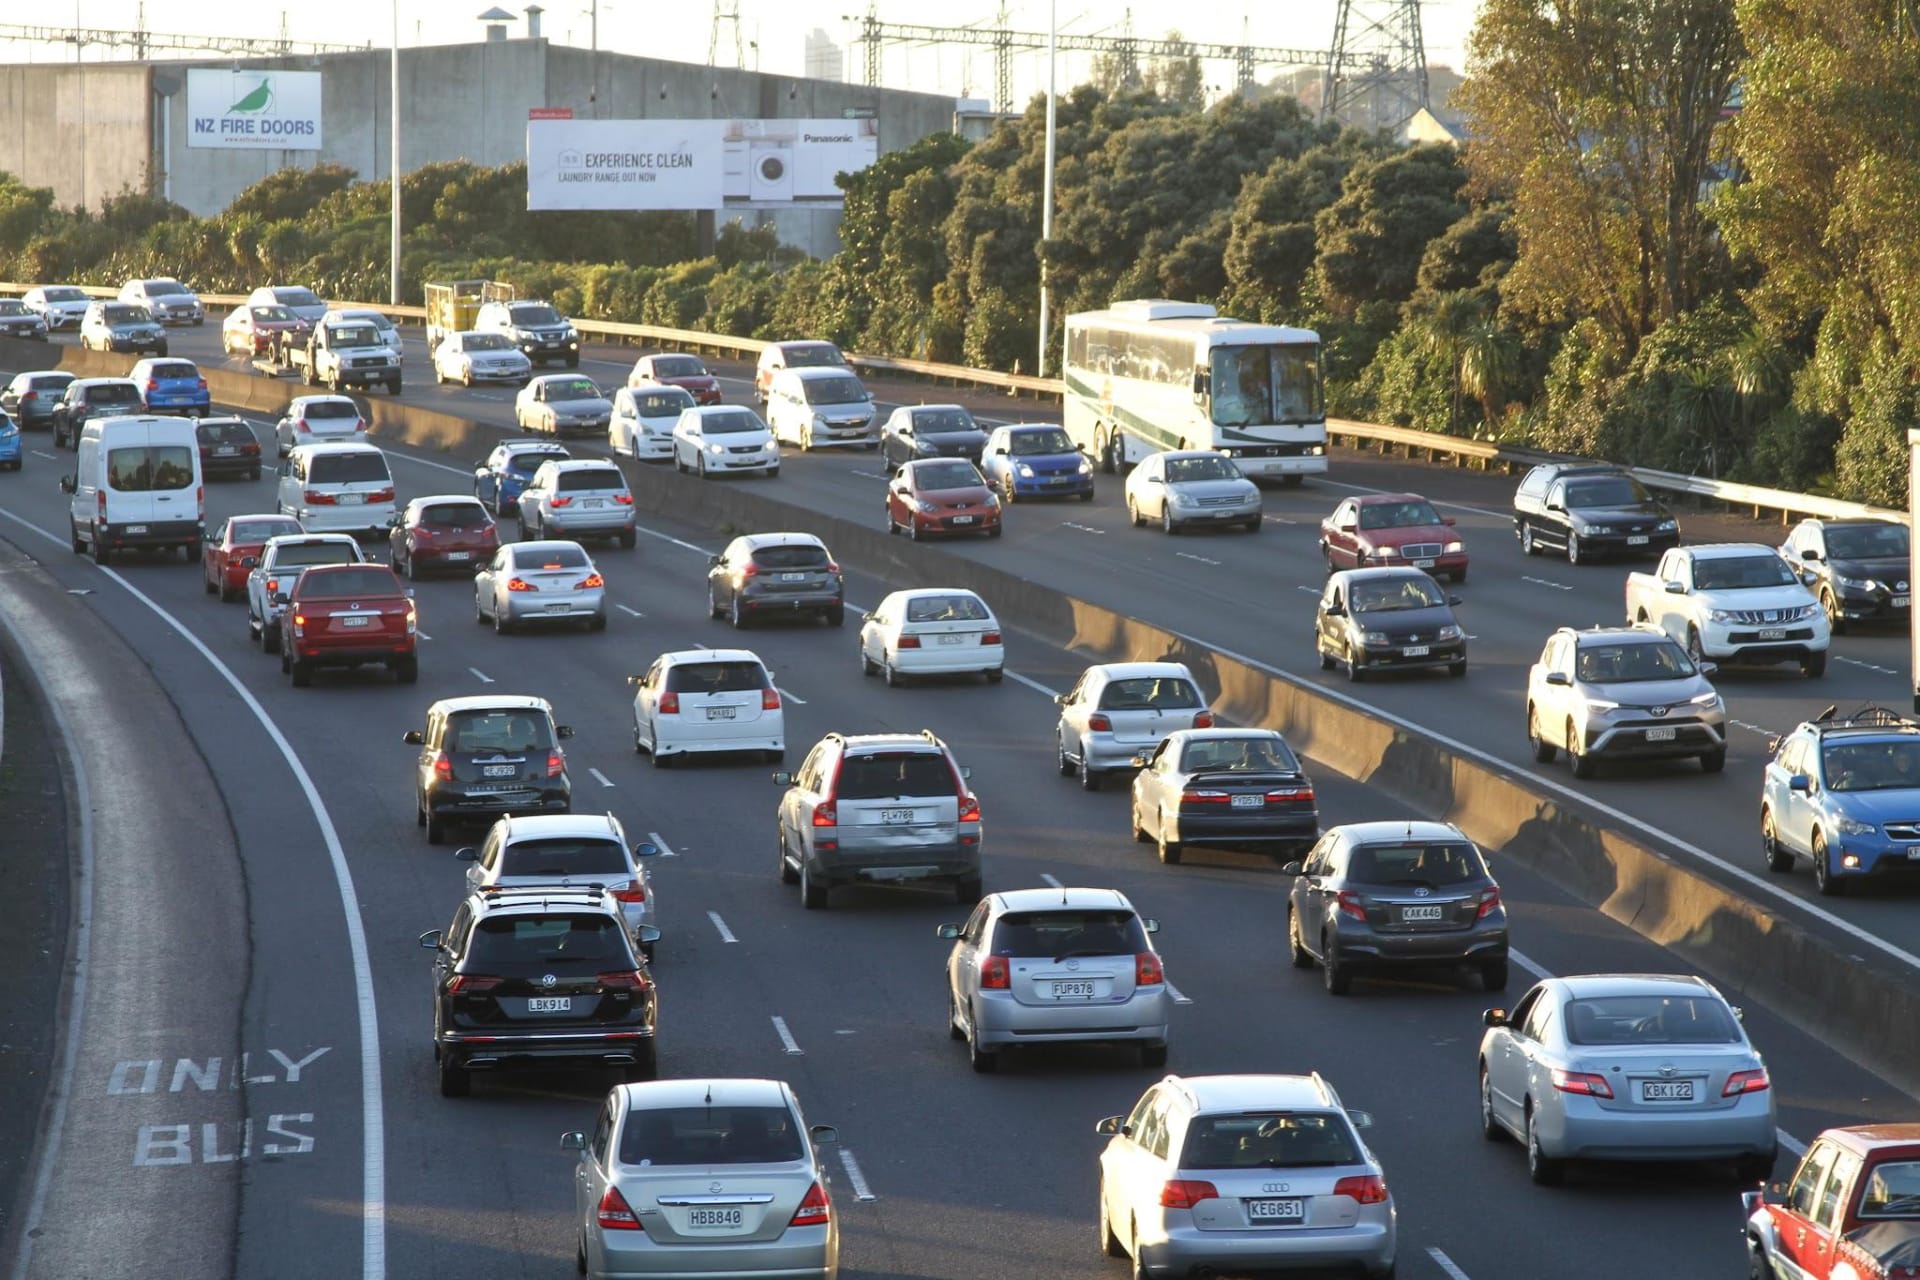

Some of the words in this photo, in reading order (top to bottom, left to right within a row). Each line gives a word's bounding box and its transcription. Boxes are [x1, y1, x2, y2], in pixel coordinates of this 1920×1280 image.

[194, 118, 215, 133] NZ
[221, 118, 255, 134] FIRE
[261, 119, 315, 135] DOORS
[803, 133, 853, 143] Panasonic
[585, 153, 652, 168] EXPERIENCE
[656, 153, 693, 168] CLEAN
[558, 172, 592, 182] LAUNDRY
[595, 173, 620, 182] RANGE
[622, 173, 636, 182] OUT
[639, 173, 656, 182] NOW
[1403, 907, 1441, 919] KAK446
[1053, 981, 1093, 995] FUP878
[529, 999, 570, 1011] LBK914
[106, 1046, 333, 1096] ONLY
[1645, 1084, 1691, 1098] KBK122
[132, 1112, 315, 1167] BUS
[1250, 1201, 1302, 1217] KEG851
[690, 1209, 742, 1225] HBB840
